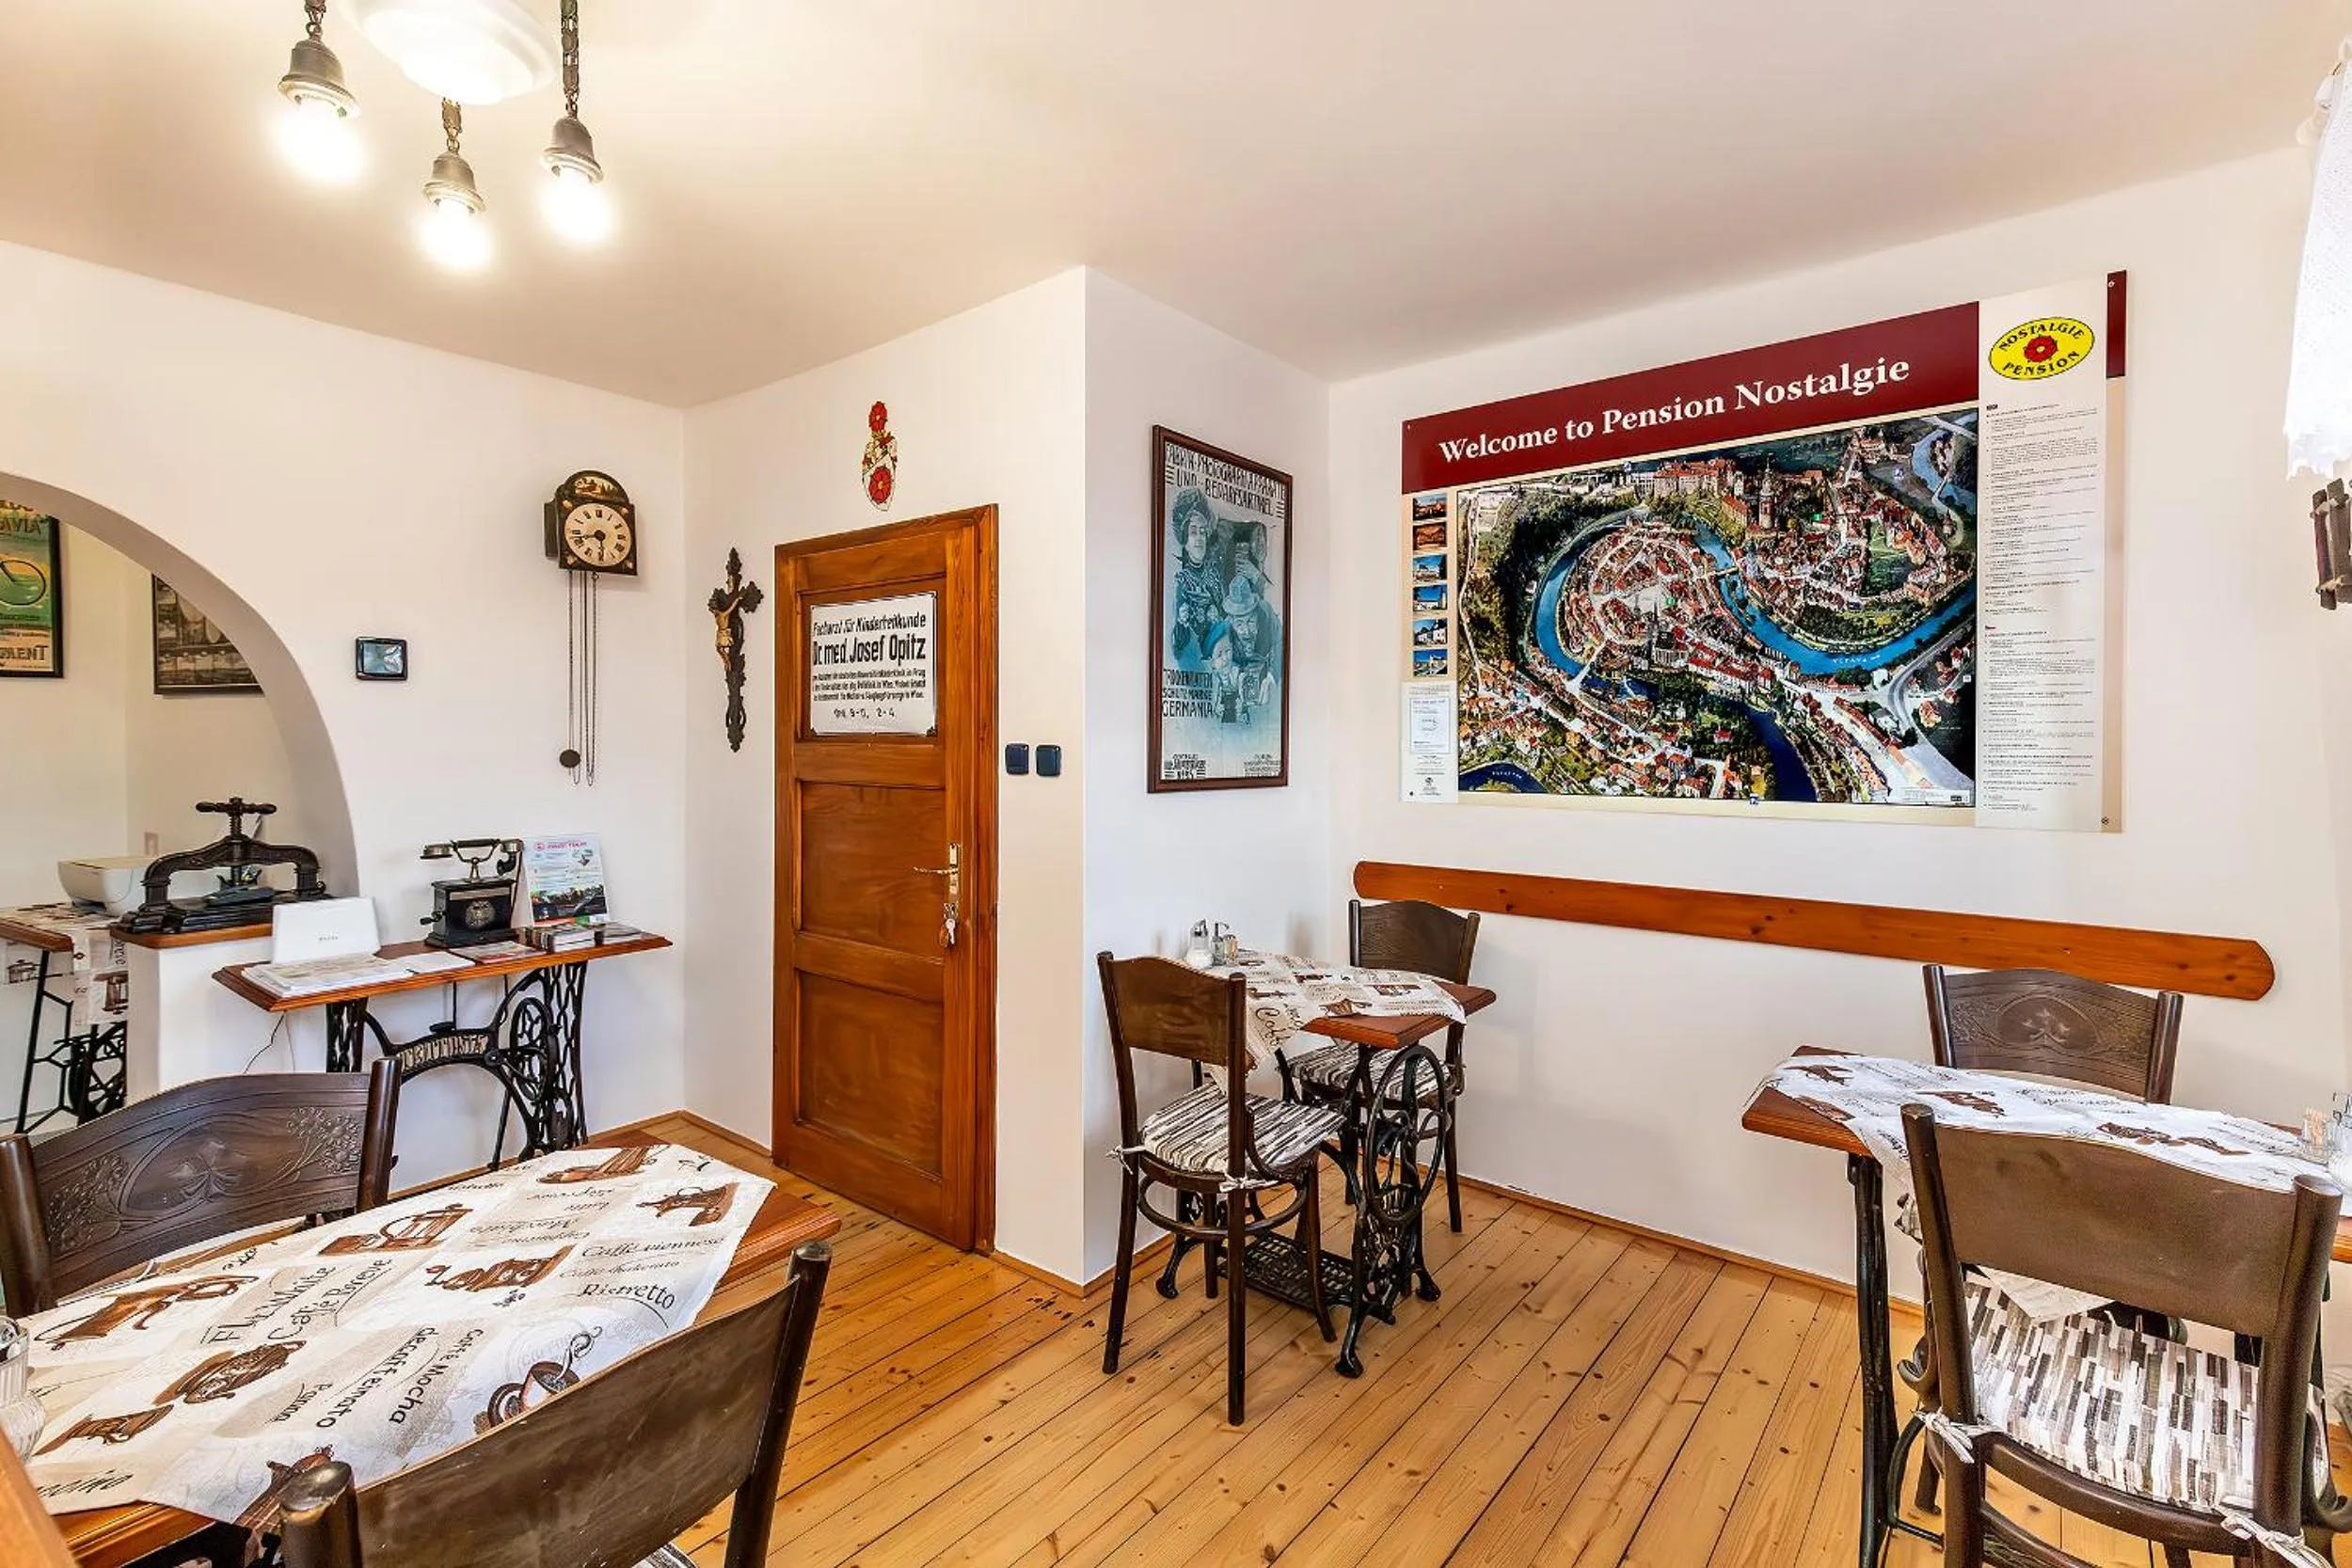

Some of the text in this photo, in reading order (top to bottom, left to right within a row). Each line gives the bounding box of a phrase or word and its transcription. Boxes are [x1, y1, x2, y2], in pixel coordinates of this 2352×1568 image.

[1998, 323, 2085, 352] NOSTALGIE
[2002, 351, 2080, 375] PENSION
[1438, 356, 1910, 464] Welcome to Pension Nostalgie
[850, 634, 885, 663] Josef
[889, 633, 926, 666] Opitz
[389, 1364, 449, 1424] Mocha
